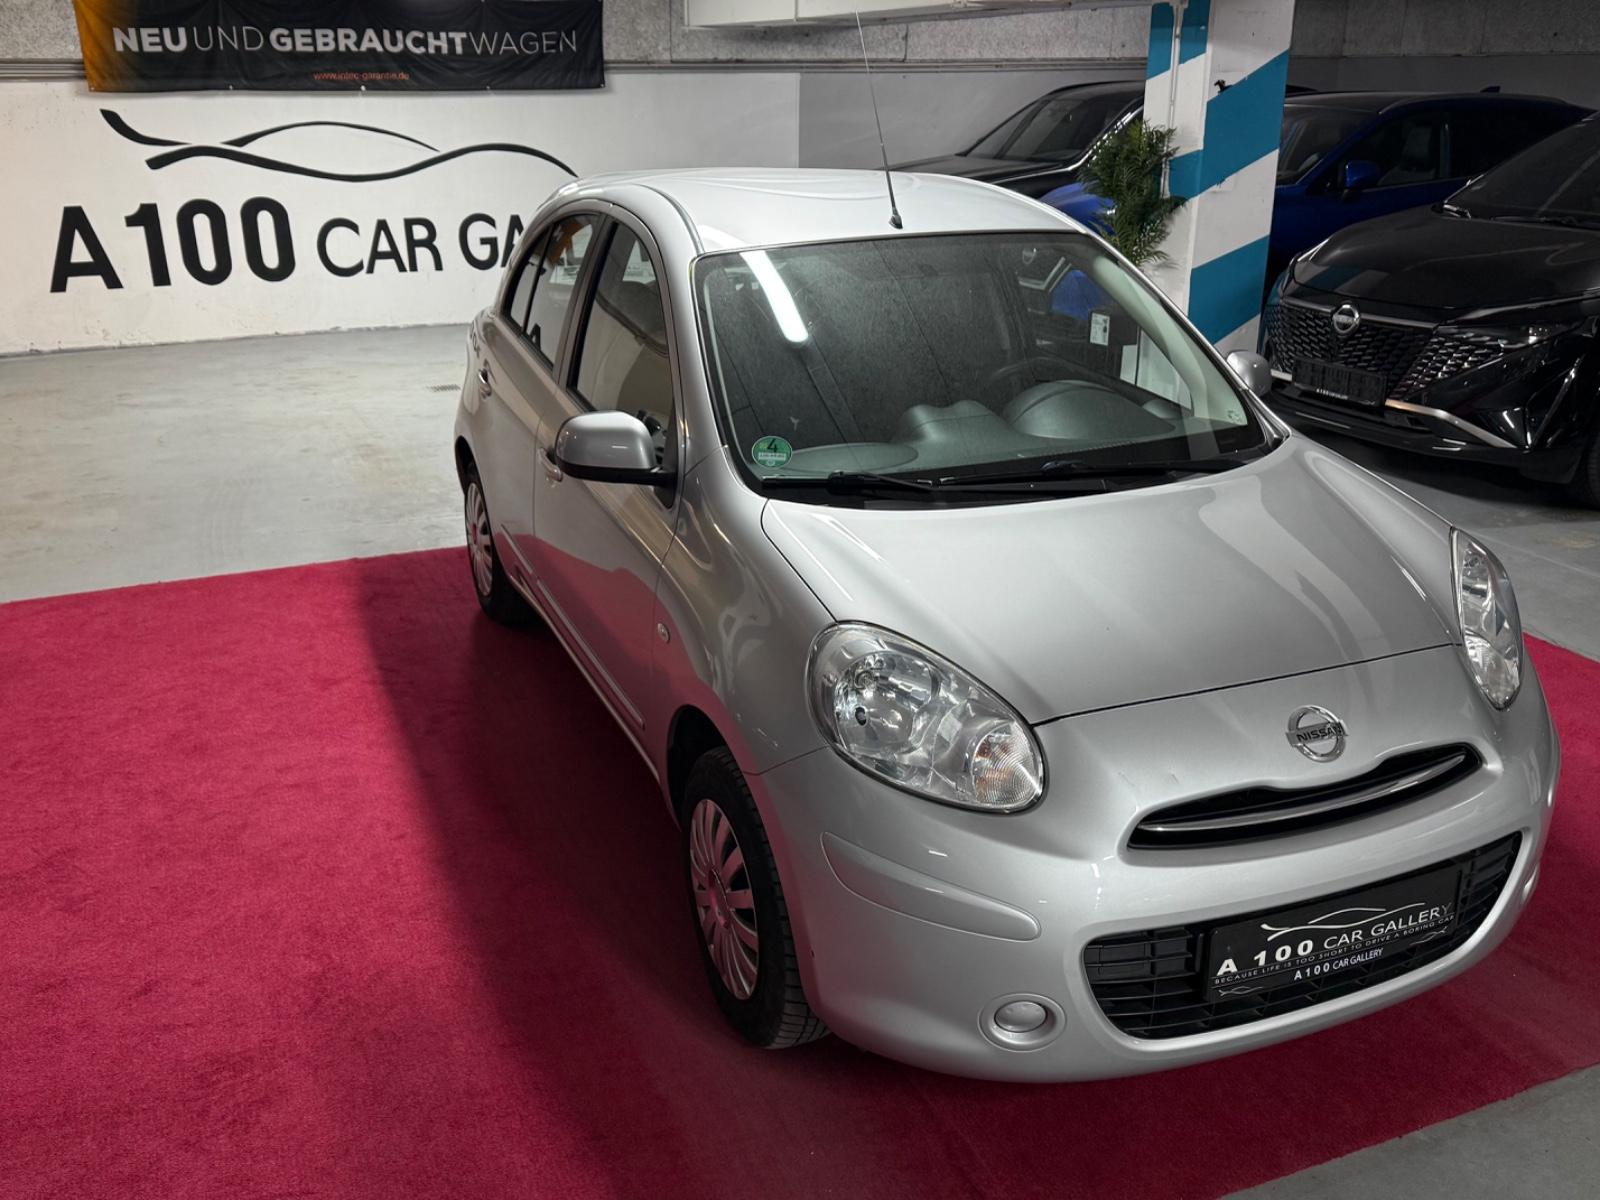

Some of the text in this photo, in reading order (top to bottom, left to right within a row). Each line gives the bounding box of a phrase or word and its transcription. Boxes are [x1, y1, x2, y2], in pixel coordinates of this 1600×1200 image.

[316, 216, 443, 277] CAR
[767, 438, 778, 453] 4
[1296, 724, 1341, 742] NISSAN
[1323, 929, 1363, 949] CAR
[1370, 902, 1452, 936] GALLERY
[1215, 969, 1258, 984] BECAUSE
[1262, 964, 1280, 974] LIFE
[1296, 955, 1315, 965] TOO
[1318, 946, 1347, 960] SHORT
[1365, 935, 1390, 946] DRIVE
[1403, 922, 1435, 936] BORING
[1438, 915, 1454, 924] CAR
[1332, 958, 1349, 970] CAR
[1349, 947, 1384, 964] GALLERY
